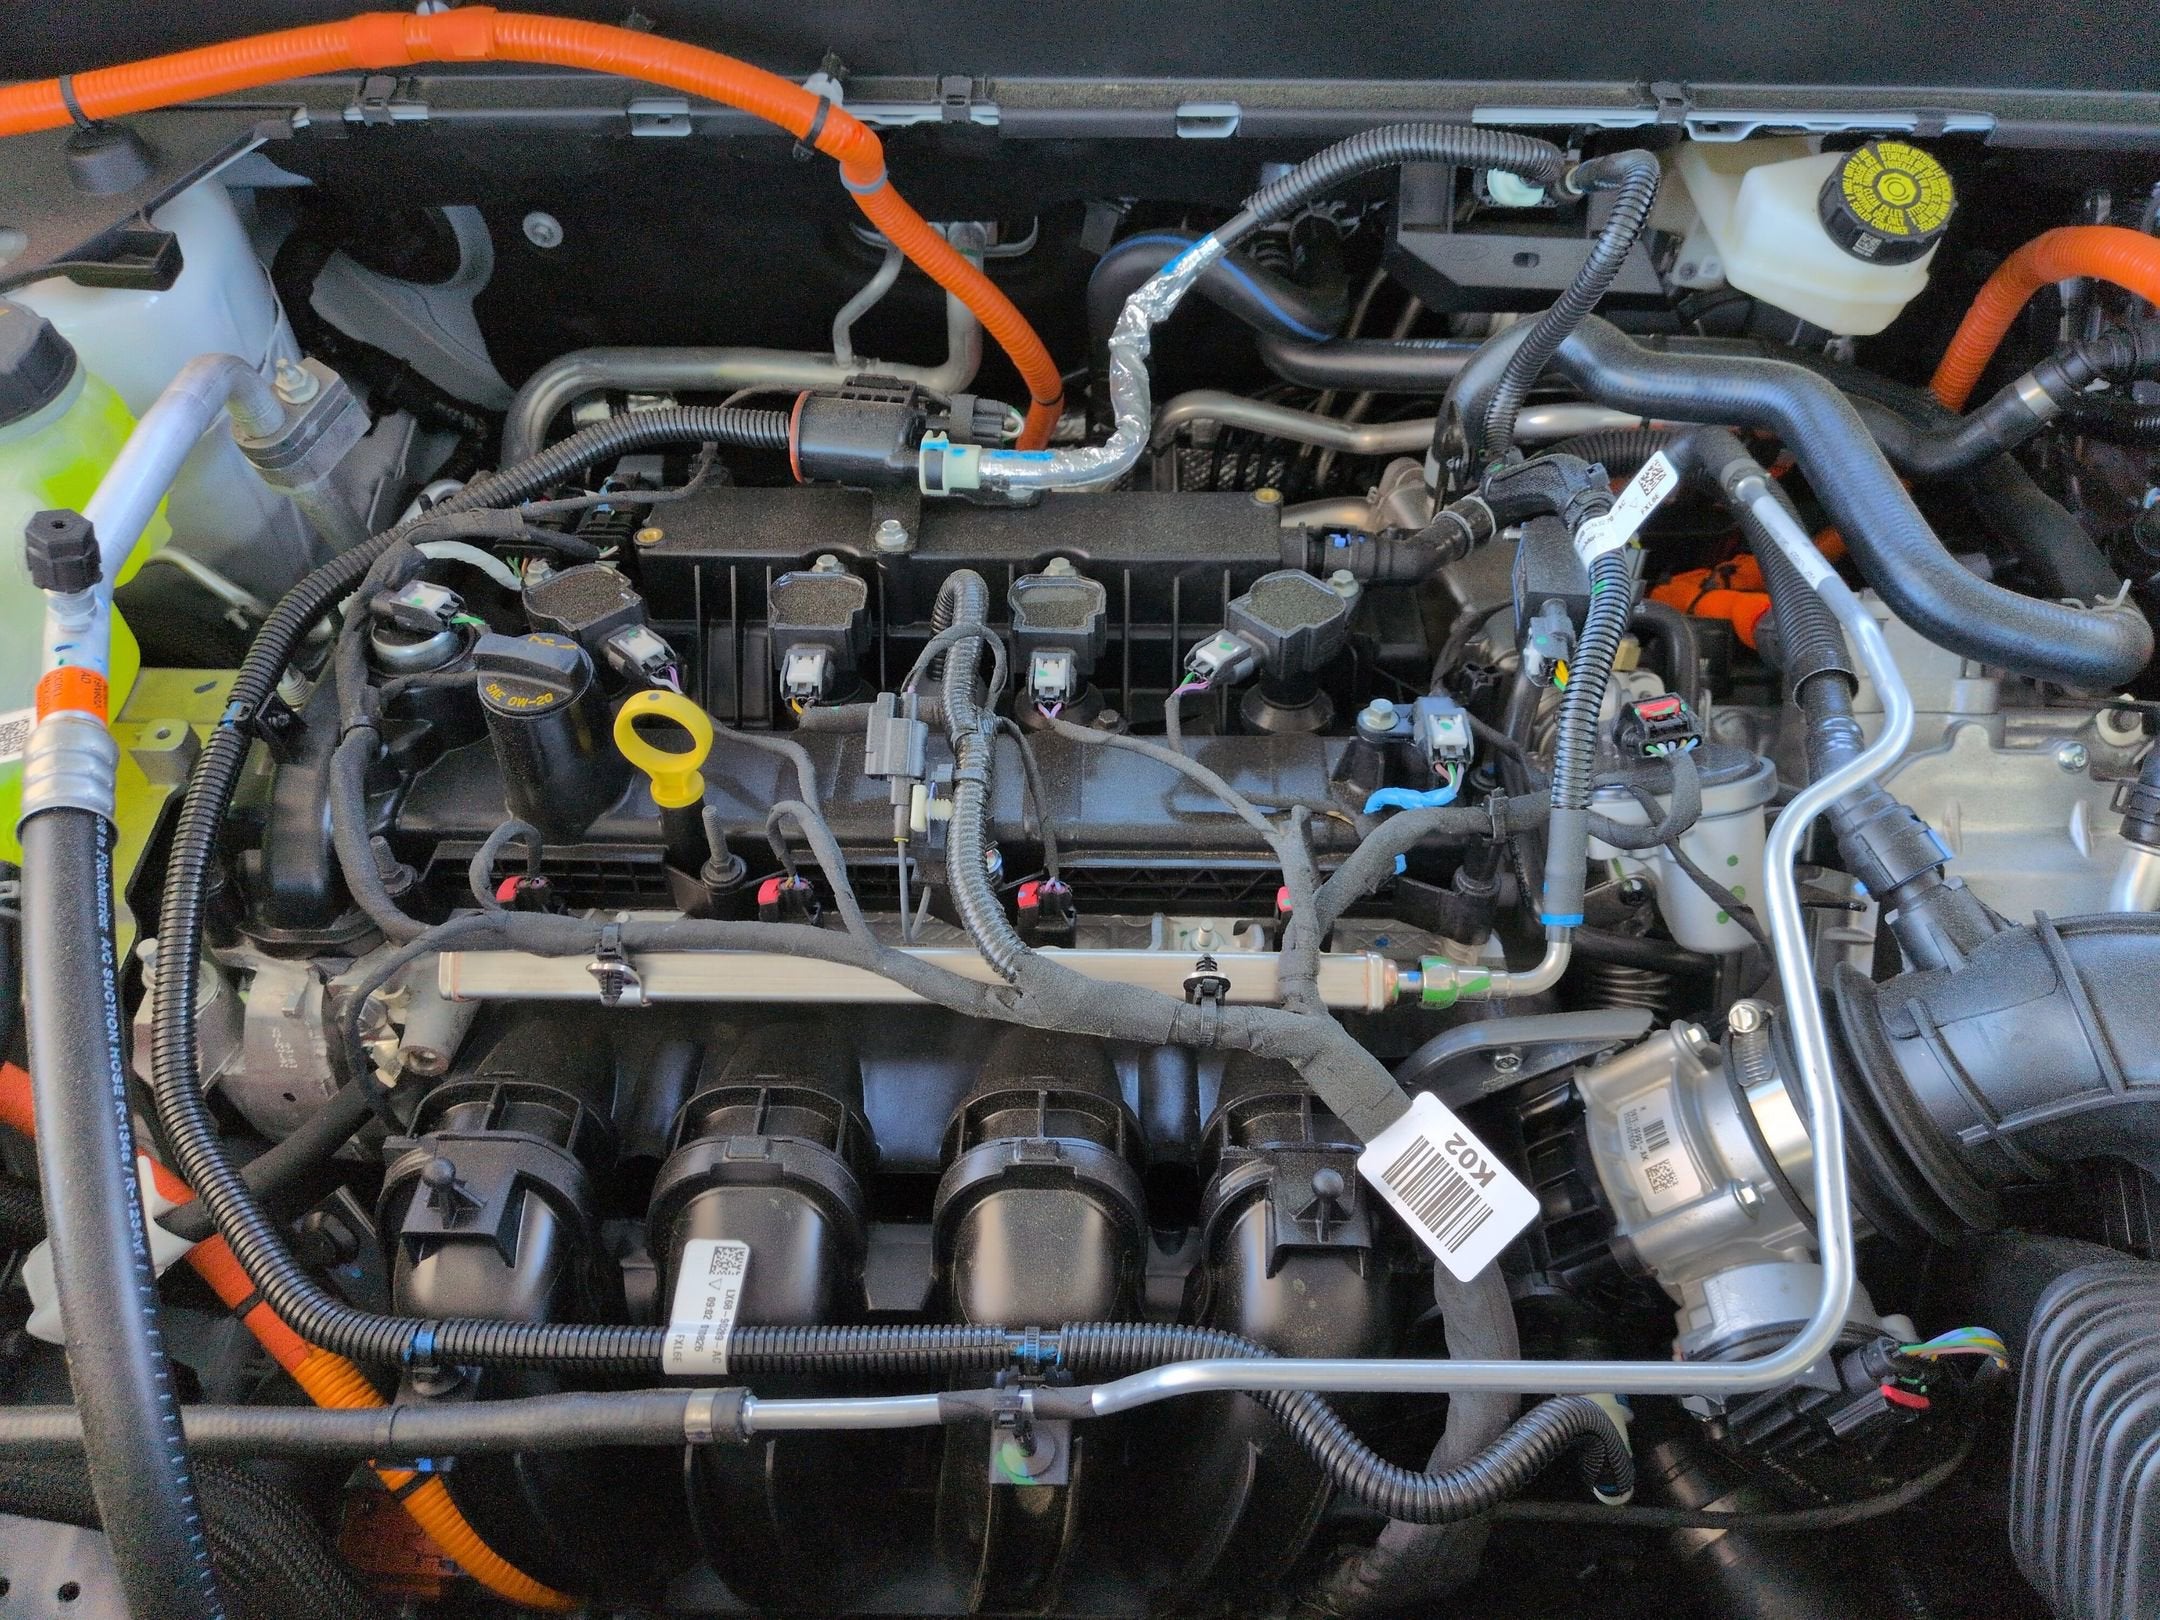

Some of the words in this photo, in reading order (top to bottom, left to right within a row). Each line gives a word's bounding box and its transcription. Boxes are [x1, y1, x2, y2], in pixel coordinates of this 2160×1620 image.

[486, 683, 506, 702] SAE
[507, 692, 554, 708] 0W-20
[101, 936, 114, 965] A/C
[102, 967, 120, 1043] SUCTION
[109, 1046, 126, 1097] HOSE
[1444, 1132, 1497, 1189] K02
